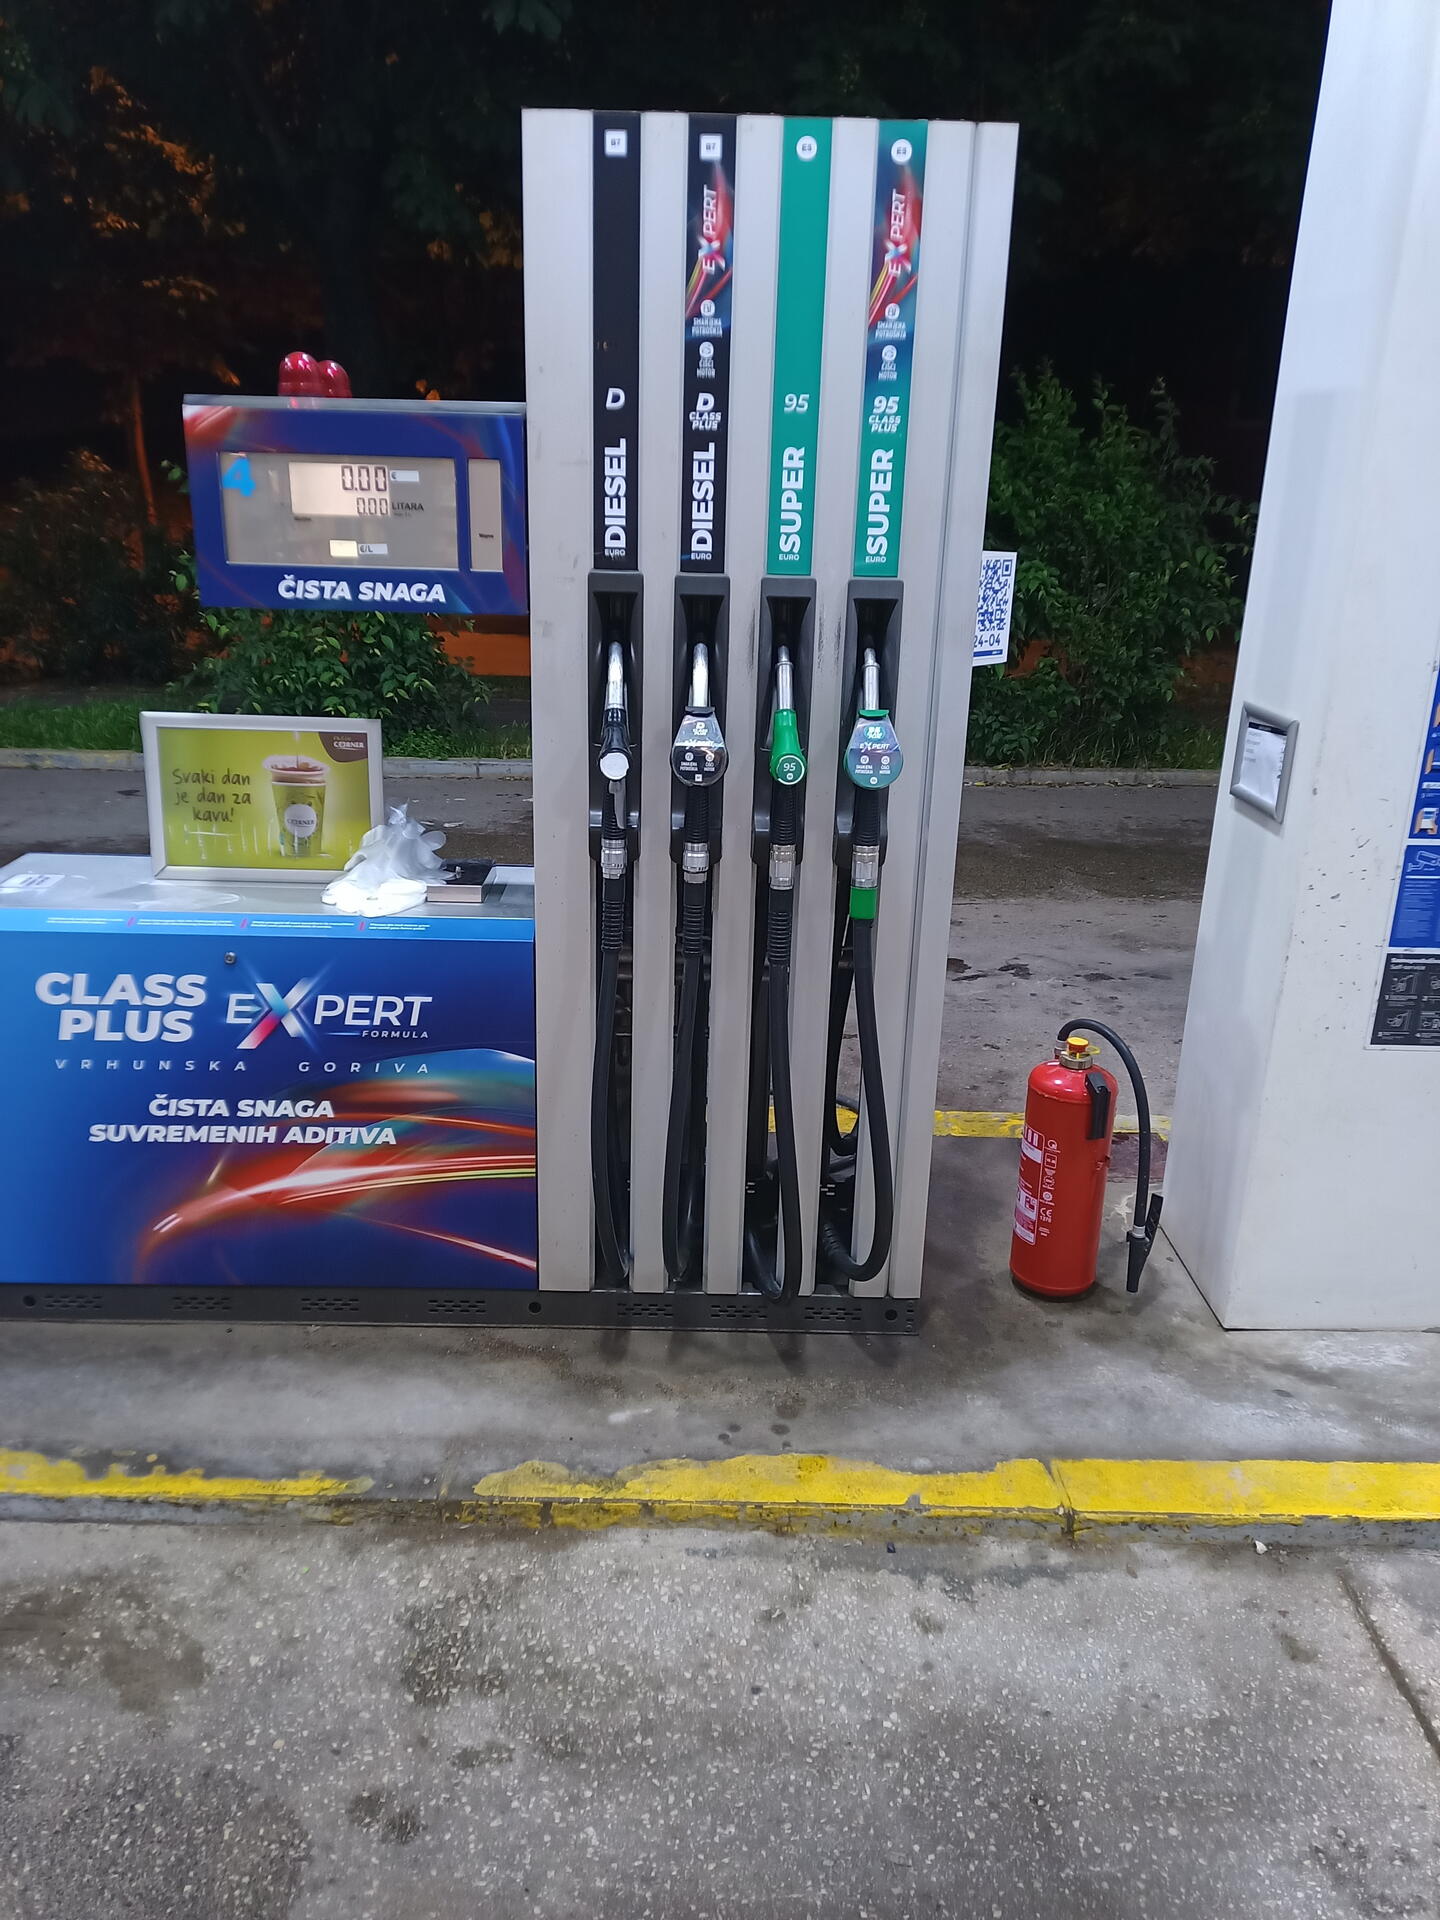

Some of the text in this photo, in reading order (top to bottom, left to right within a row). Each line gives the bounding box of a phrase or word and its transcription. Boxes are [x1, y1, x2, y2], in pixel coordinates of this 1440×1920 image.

[698, 184, 725, 275] EXPERT
[885, 188, 912, 276] EXPERT
[605, 387, 625, 410] D
[696, 392, 715, 412] D
[783, 393, 810, 413] 95
[872, 395, 900, 415] 95
[689, 411, 721, 421] CLASS
[692, 420, 718, 431] PLUS
[868, 415, 901, 424] CLASS
[871, 423, 898, 433] PLUS
[222, 457, 256, 497] 4
[341, 465, 387, 492] 0.00
[604, 438, 627, 548] DIESEL
[691, 442, 715, 551] DIESEL
[779, 446, 805, 553] SUPER
[866, 448, 894, 555] SUPER
[392, 502, 424, 512] LITARA
[604, 549, 626, 557] EURO
[690, 552, 712, 560] EURO
[278, 574, 446, 604] ČISTA SNAGA
[172, 766, 251, 786] Svaki dan
[783, 762, 796, 772] 95
[174, 788, 251, 805] je dan za
[192, 807, 234, 823] kavu!
[34, 972, 207, 1007] CLASS
[226, 977, 433, 1049] EXPERT
[58, 1009, 193, 1043] PLUS
[361, 1030, 429, 1039] FORMULA
[55, 1059, 429, 1074] VRHUNSKA GORIVA
[148, 1093, 334, 1118] ČISTA SNAGA
[88, 1123, 397, 1145] SUVREMENIH ADITIVA
